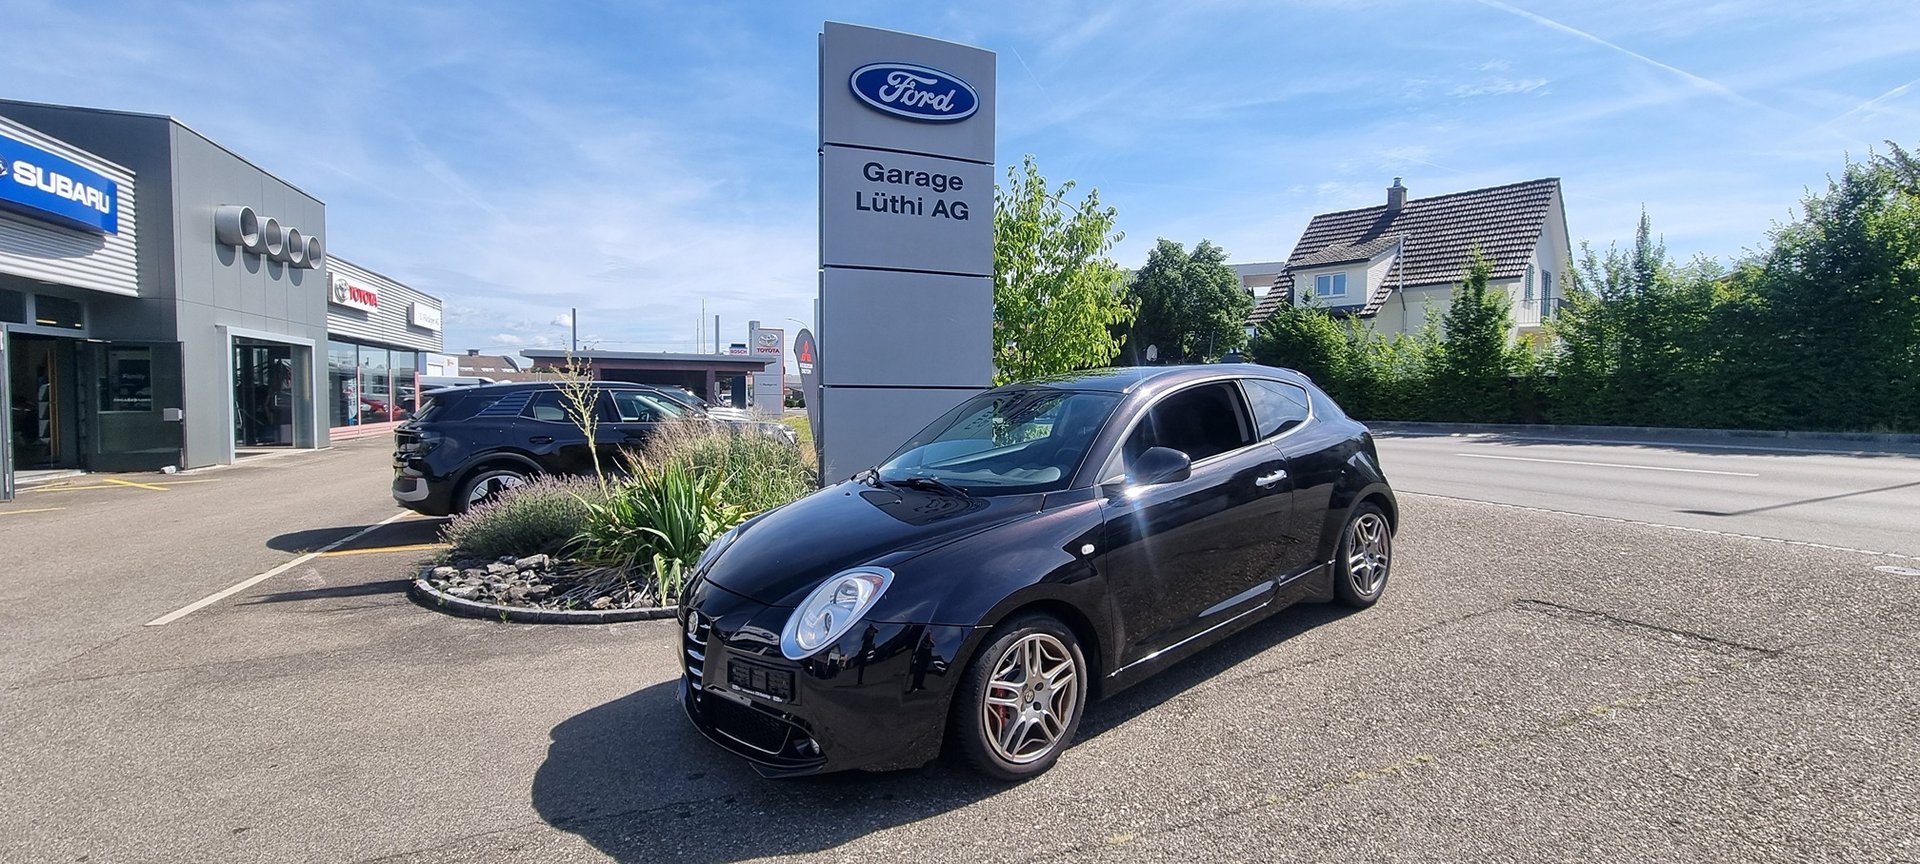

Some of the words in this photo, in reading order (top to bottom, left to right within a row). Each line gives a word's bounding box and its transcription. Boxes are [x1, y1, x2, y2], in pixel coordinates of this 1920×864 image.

[878, 70, 956, 112] Ford
[12, 160, 110, 214] SUBARU
[863, 161, 964, 192] Garage
[856, 191, 923, 216] Lüthi
[931, 199, 969, 221] AG
[348, 285, 378, 308] TOYOTA
